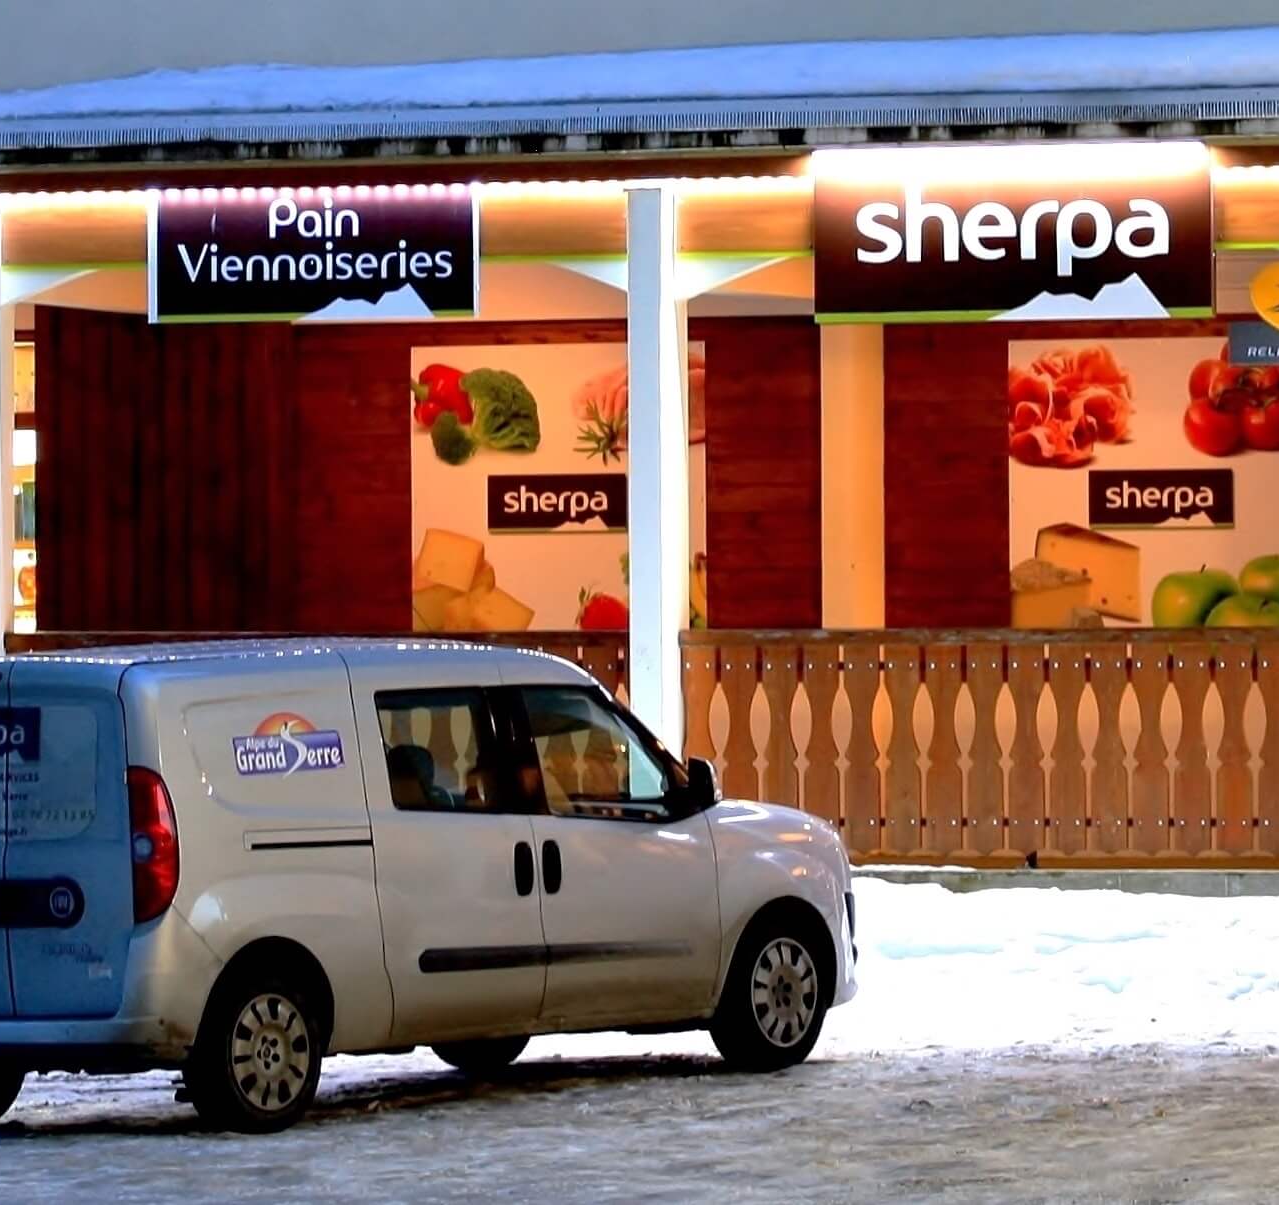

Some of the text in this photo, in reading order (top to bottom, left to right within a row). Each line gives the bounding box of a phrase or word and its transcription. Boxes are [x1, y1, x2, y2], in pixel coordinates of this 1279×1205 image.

[268, 197, 360, 239] Pain
[855, 182, 1170, 277] sherpa
[177, 239, 453, 283] Viennoiseries
[504, 485, 609, 518] sherpa
[1105, 480, 1214, 513] sherpa
[236, 743, 288, 772] Grand
[245, 736, 280, 753] Alpe du
